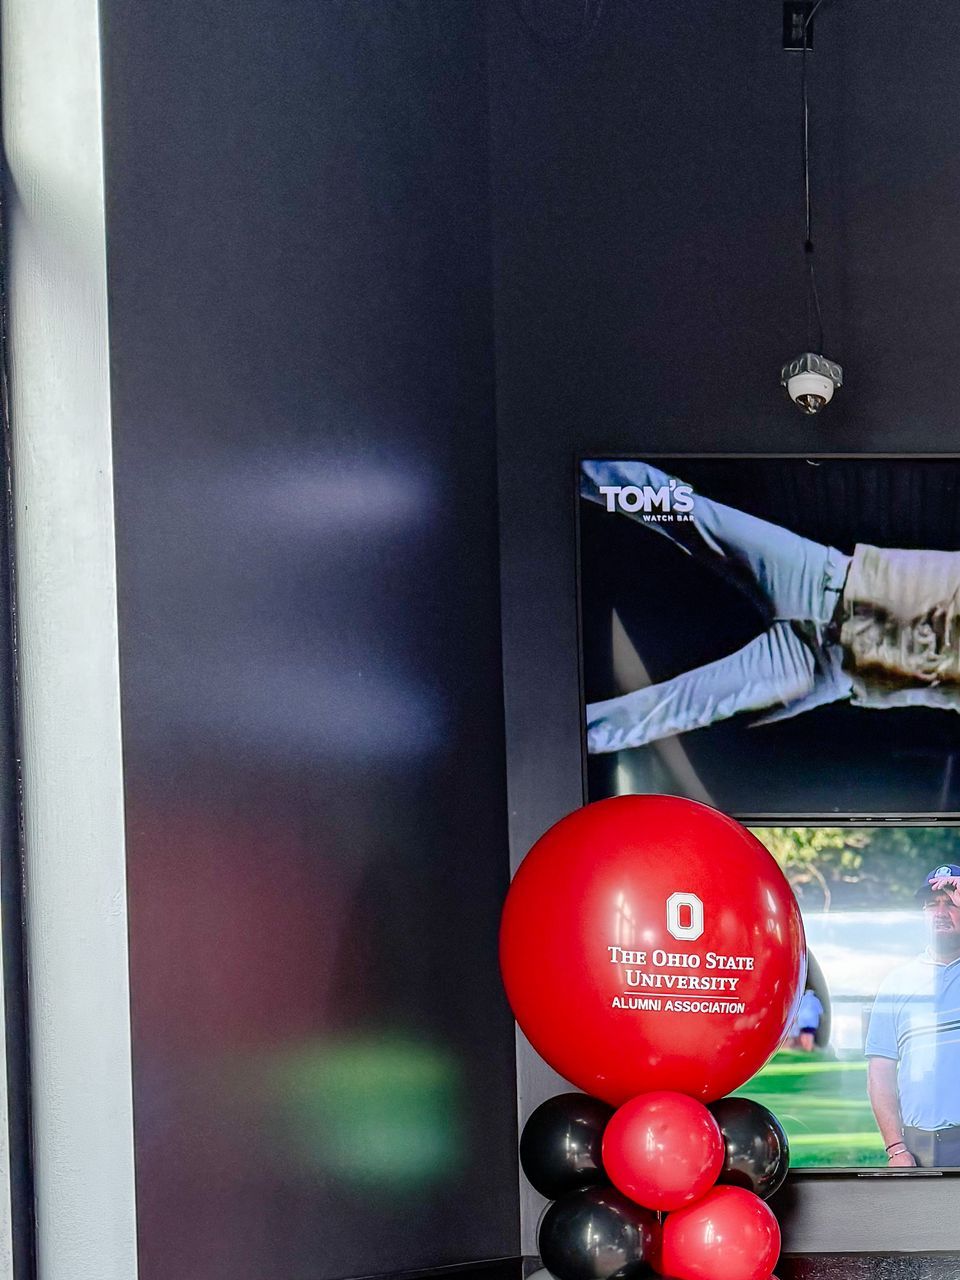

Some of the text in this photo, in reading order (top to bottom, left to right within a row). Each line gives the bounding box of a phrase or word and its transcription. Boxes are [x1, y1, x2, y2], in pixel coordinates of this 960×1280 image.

[600, 480, 694, 512] TOM'S
[612, 997, 745, 1014] ALUMNI ASSOCIATION
